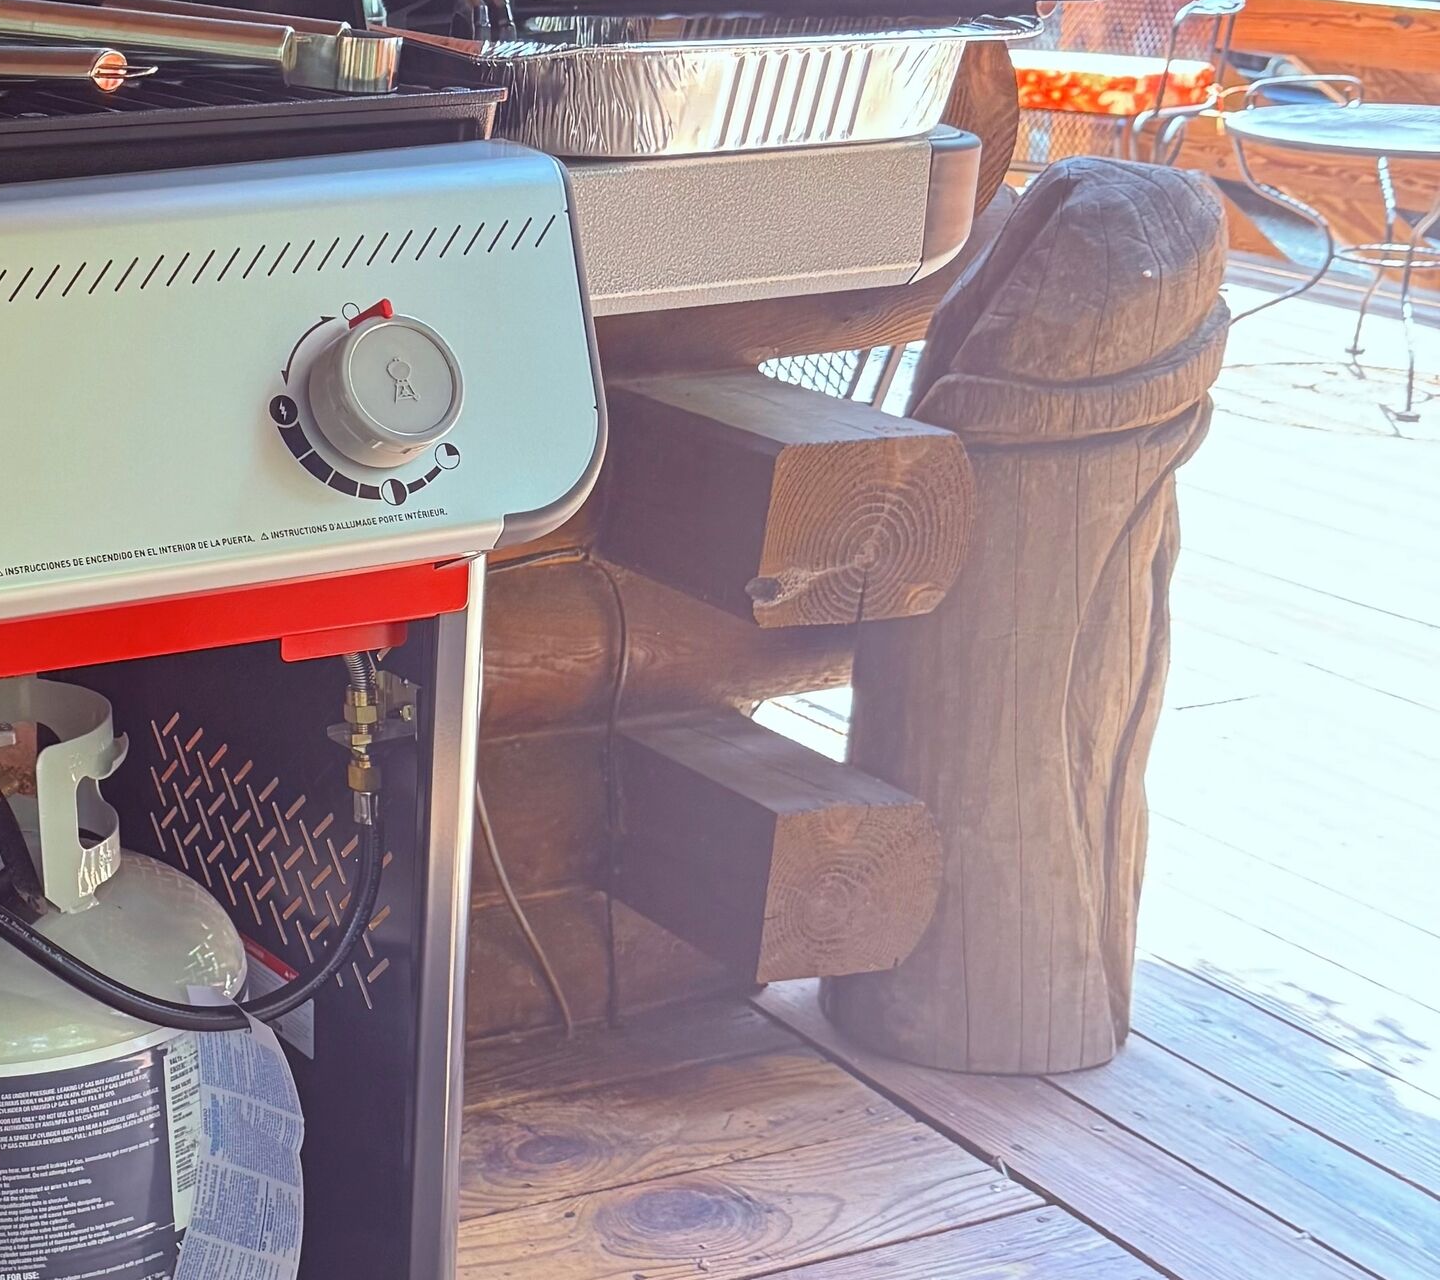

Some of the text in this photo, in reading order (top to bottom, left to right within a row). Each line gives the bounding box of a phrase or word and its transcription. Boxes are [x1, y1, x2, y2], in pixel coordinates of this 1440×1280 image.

[271, 507, 448, 539] INSTRUCTIONS D'ALLUMAGE PORTE INTÉRIEUR.
[5, 534, 256, 576] INSTRUCCIONES DE ENCENDIDO EN EL INTERIOR DE LA PUERTA.
[6, 1273, 22, 1280] FOR
[22, 1271, 39, 1280] USE:
